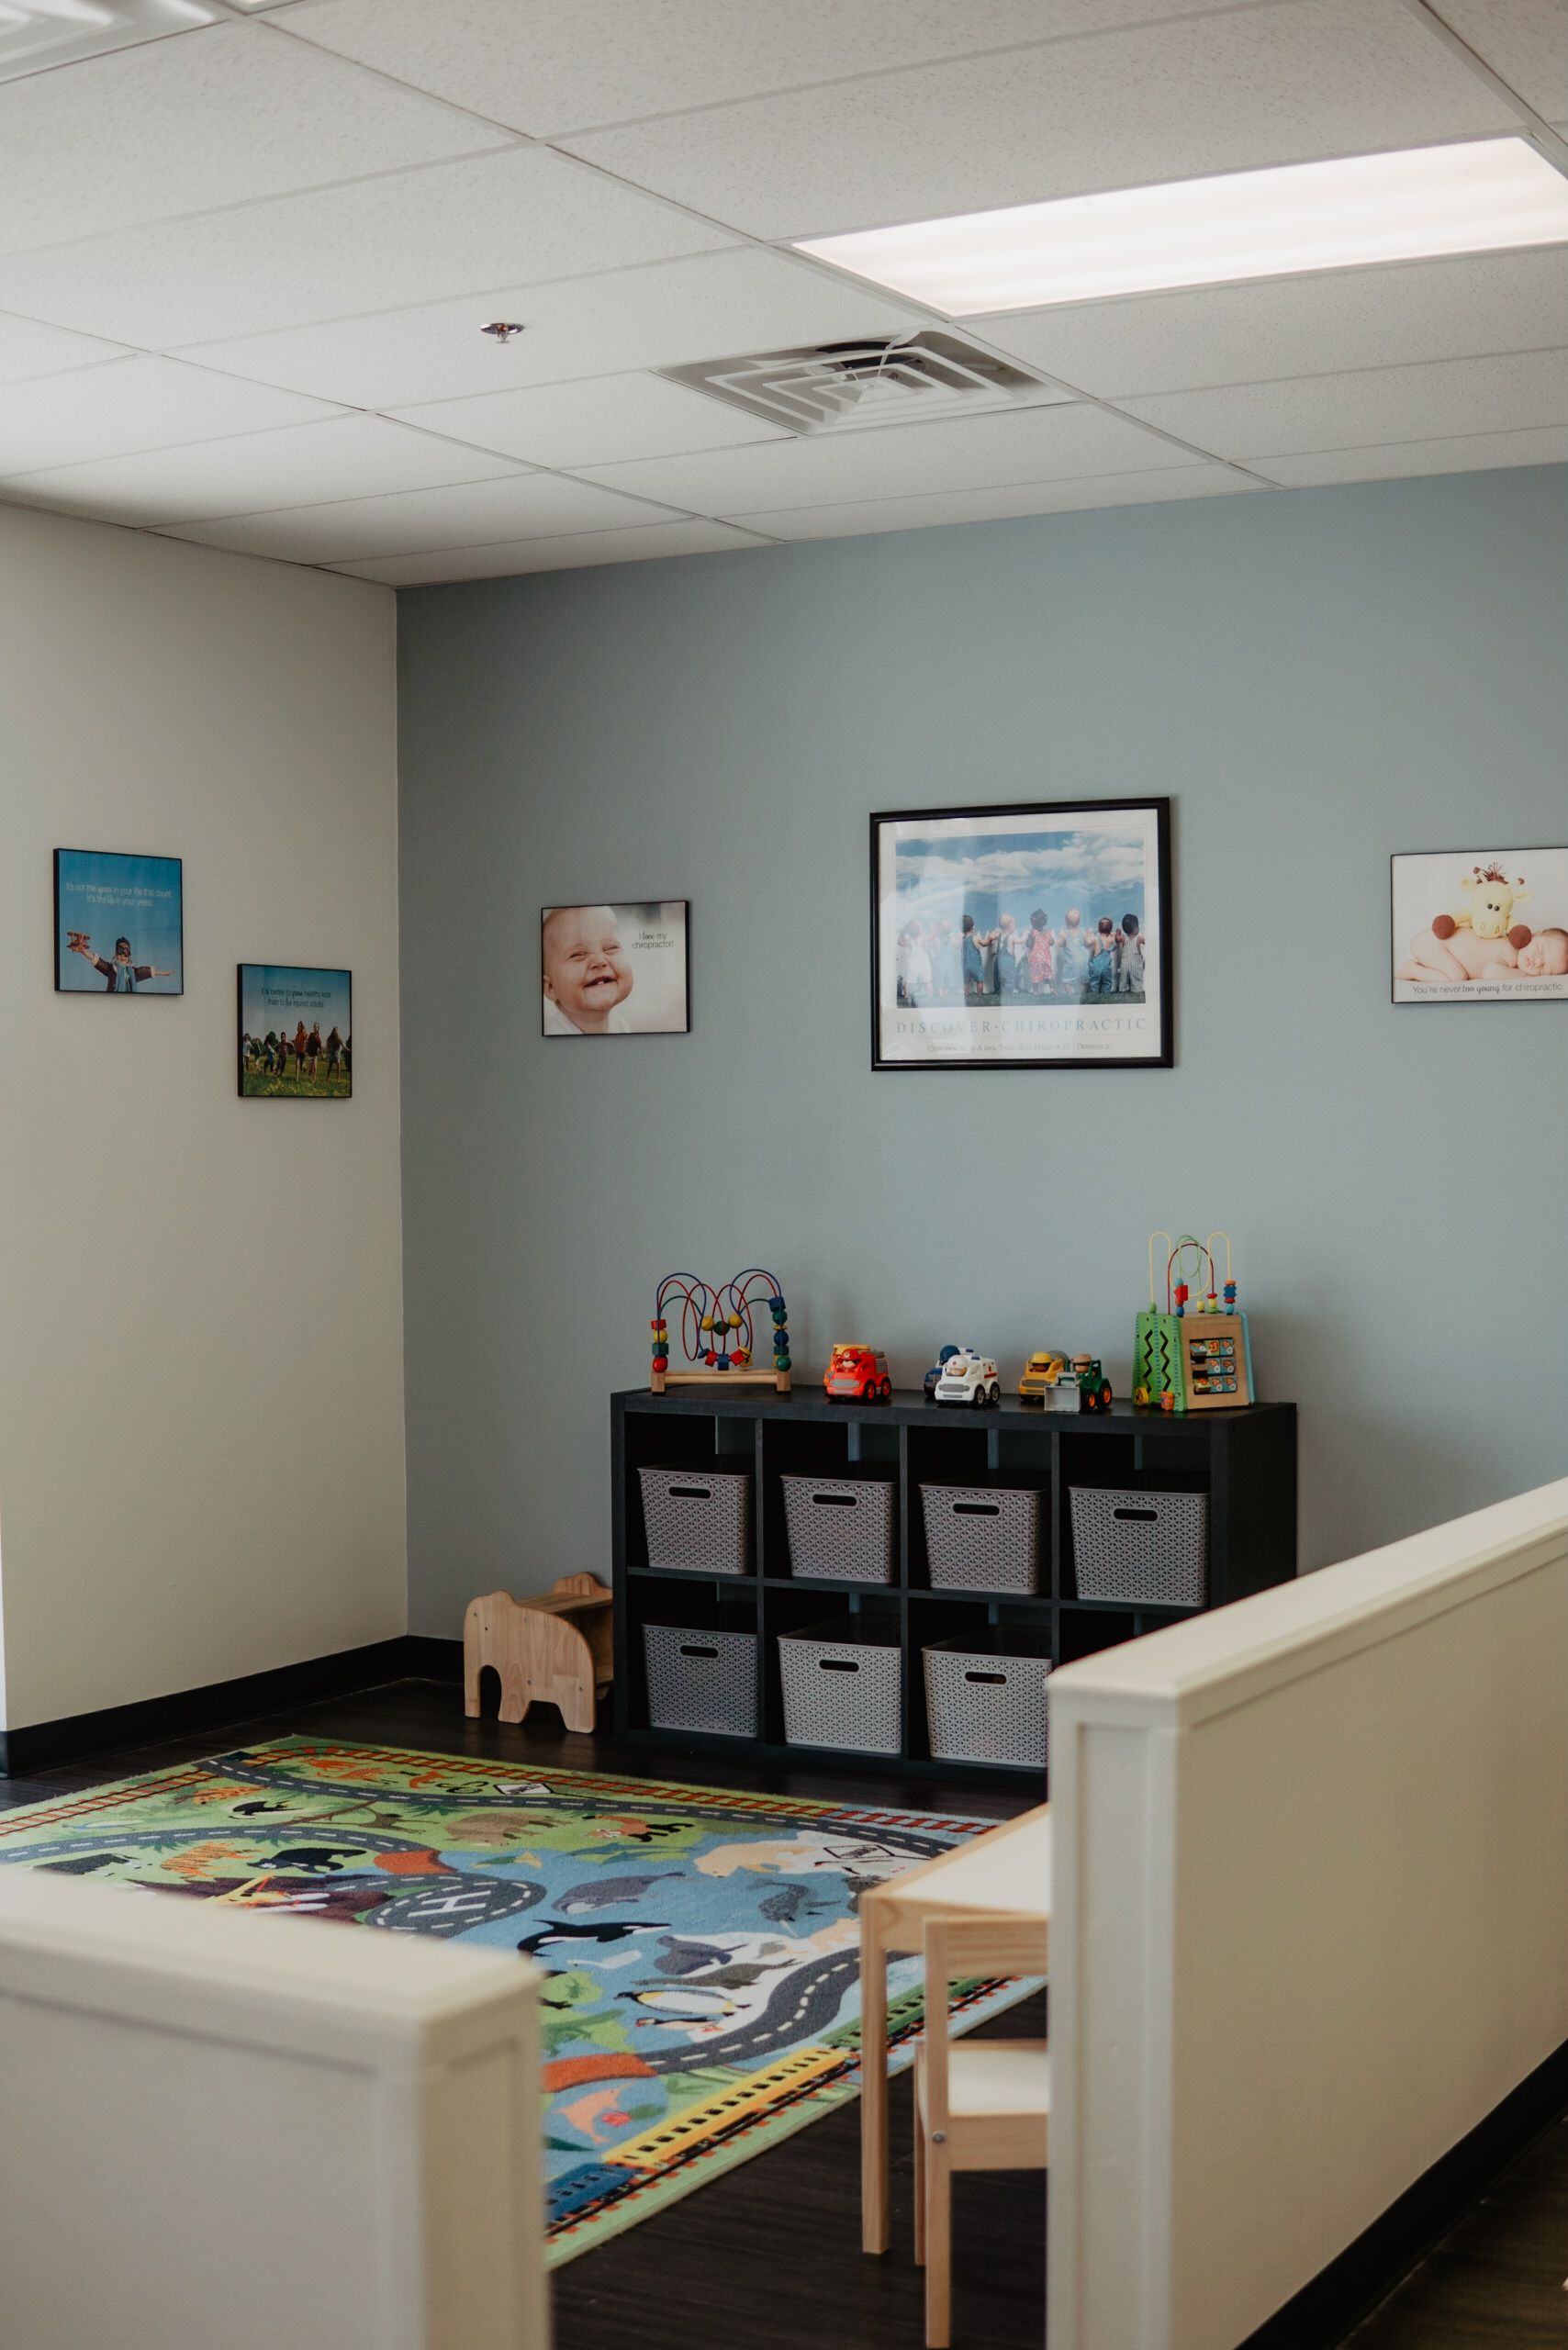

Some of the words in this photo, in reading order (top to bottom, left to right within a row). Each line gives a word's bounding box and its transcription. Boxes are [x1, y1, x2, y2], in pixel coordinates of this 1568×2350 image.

[656, 932, 668, 942] my
[1412, 985, 1438, 995] You're
[1439, 985, 1461, 994] never
[1462, 984, 1475, 993] too
[1476, 985, 1500, 995] young
[1502, 983, 1513, 992] for
